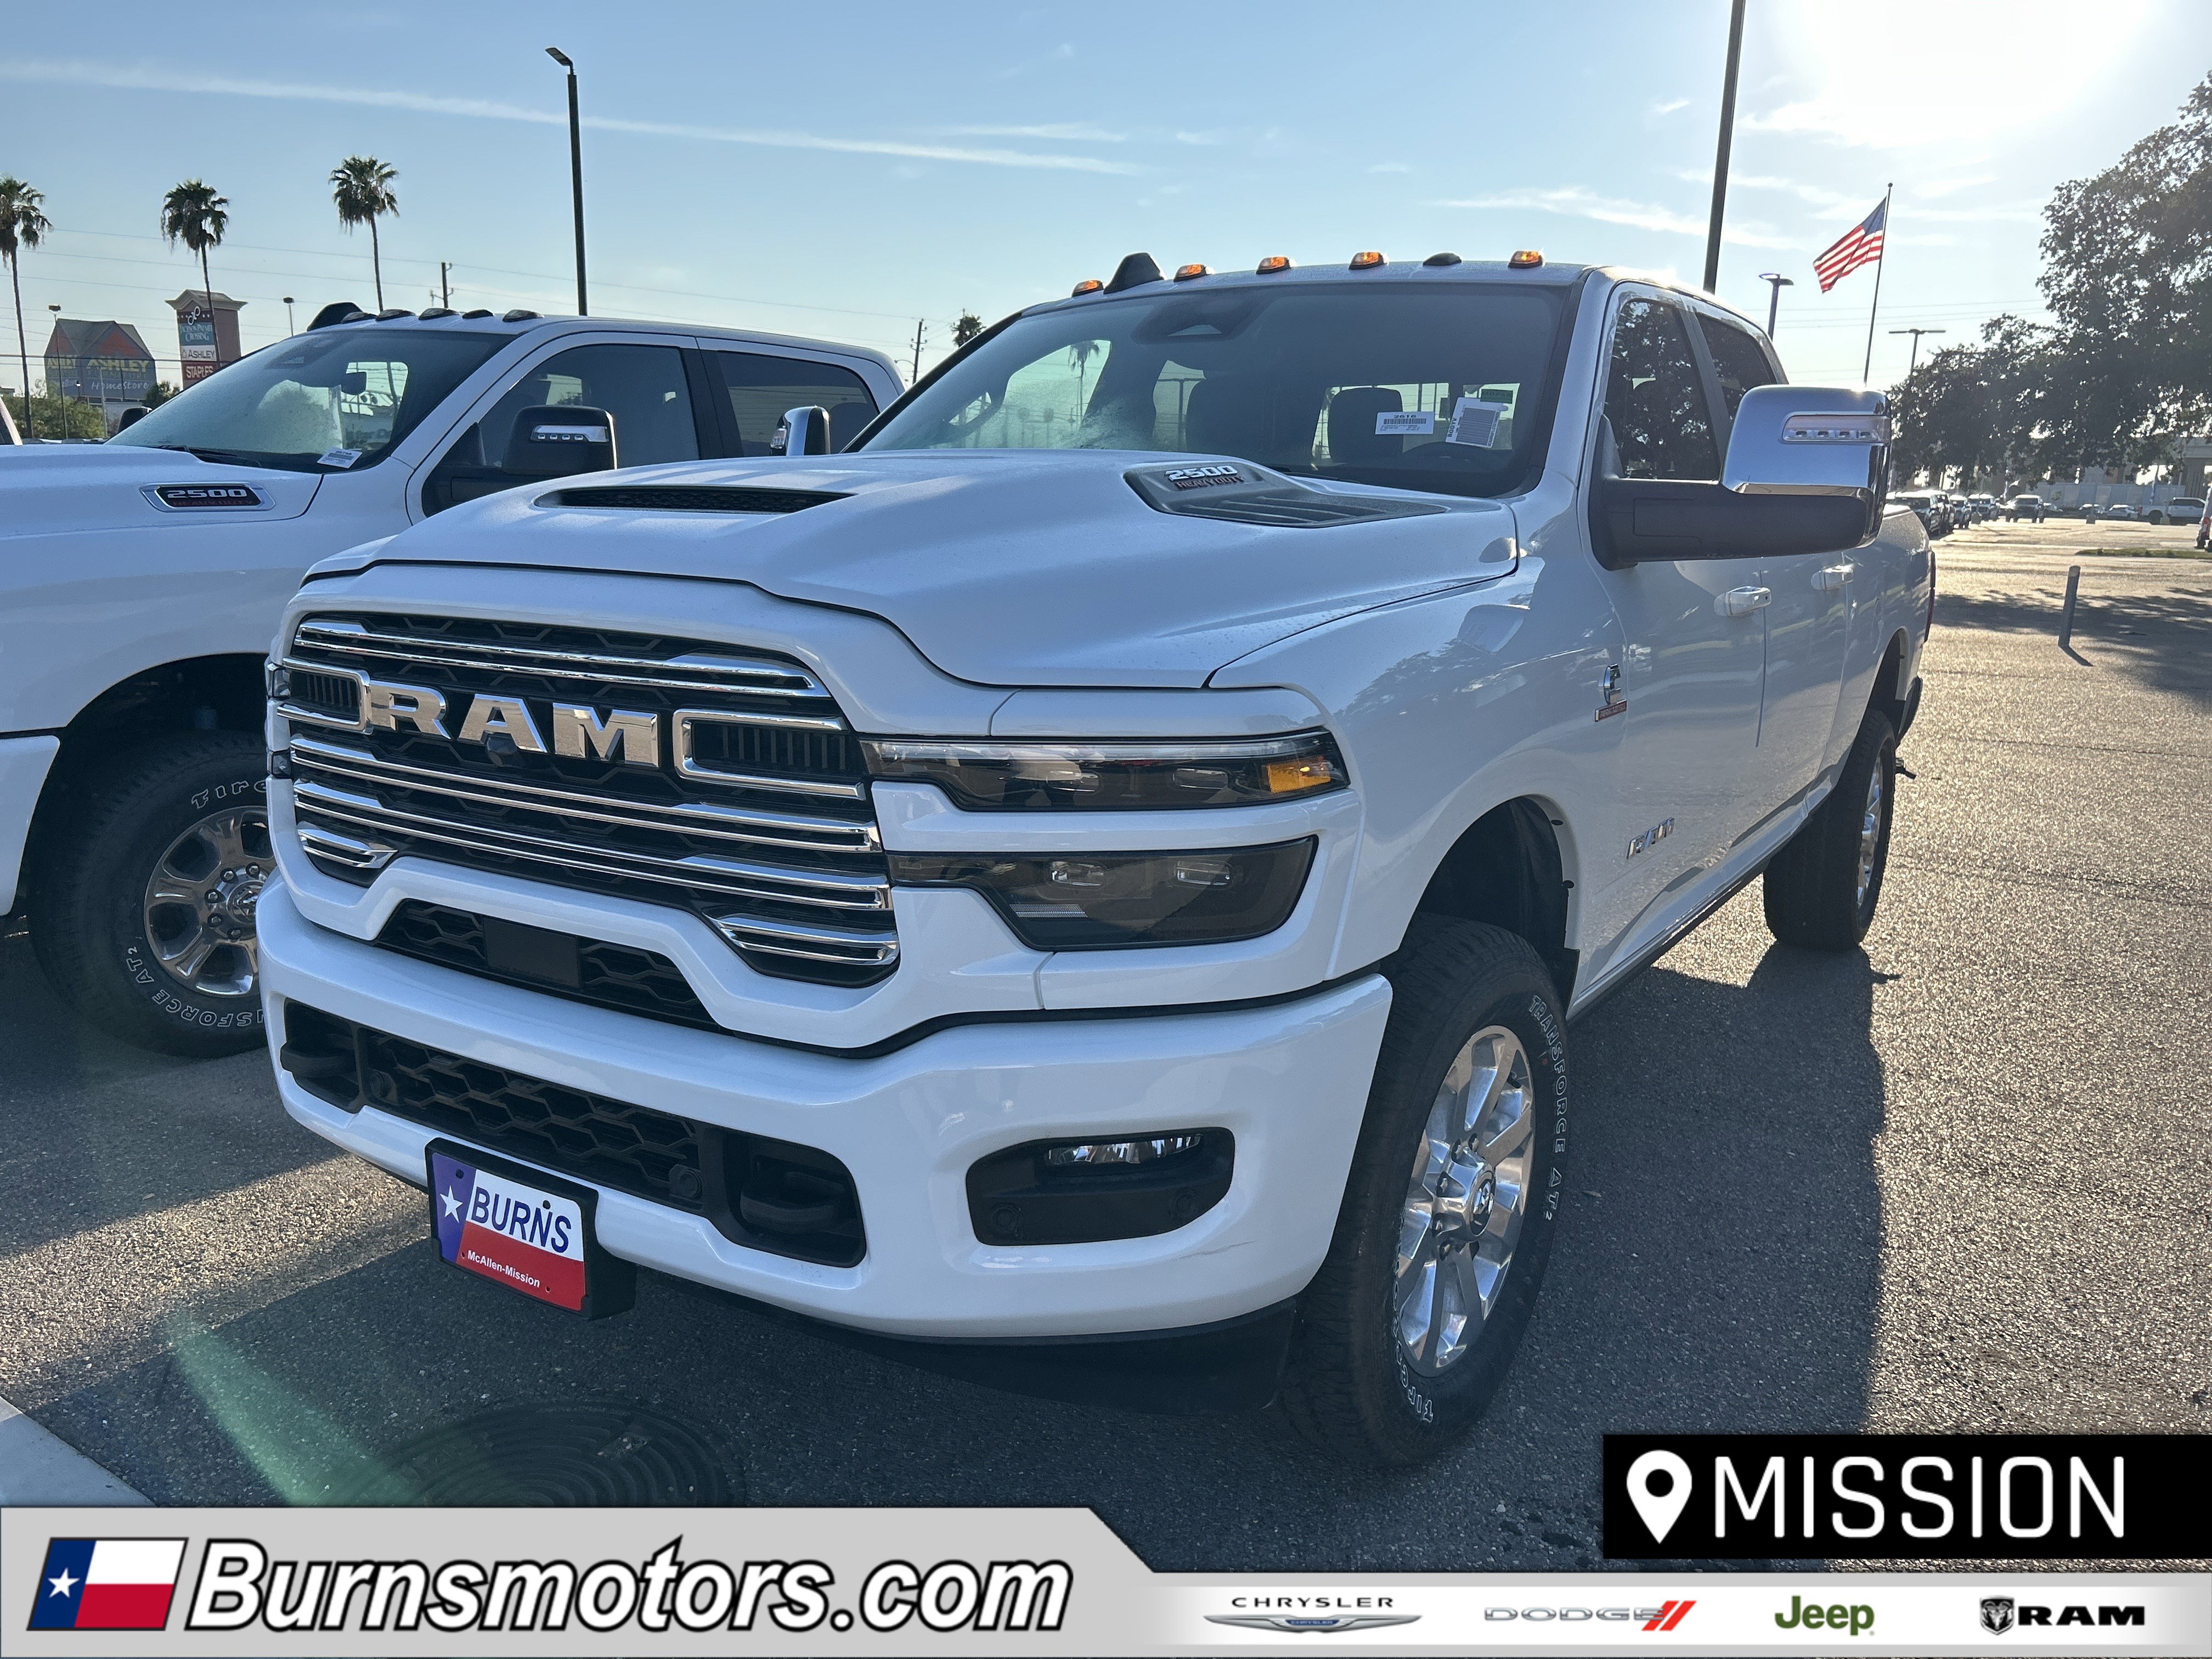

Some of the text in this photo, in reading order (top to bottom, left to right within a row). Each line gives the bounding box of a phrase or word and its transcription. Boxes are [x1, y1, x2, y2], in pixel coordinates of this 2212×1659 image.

[188, 349, 215, 359] ASHLEY
[86, 357, 149, 373] ASHLEY
[186, 365, 213, 379] STAPLES
[1165, 465, 1238, 481] 2500
[1175, 475, 1245, 490] HEAVY DUTY
[167, 489, 247, 498] 2500
[370, 680, 659, 768] RAM
[1529, 995, 1567, 1154] TRANSFORCE
[470, 1186, 572, 1253] BURNS
[467, 1250, 540, 1288] McAllen-Mission
